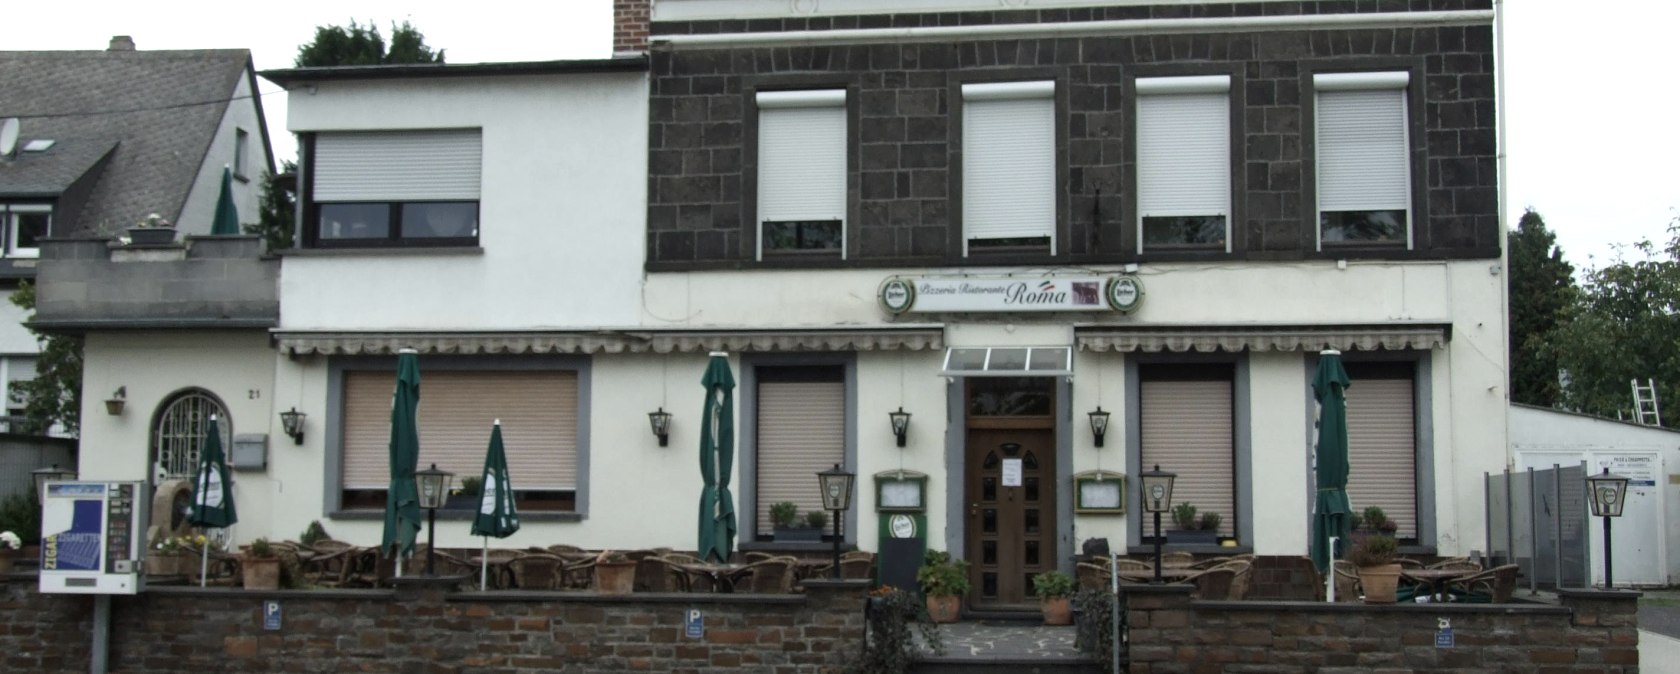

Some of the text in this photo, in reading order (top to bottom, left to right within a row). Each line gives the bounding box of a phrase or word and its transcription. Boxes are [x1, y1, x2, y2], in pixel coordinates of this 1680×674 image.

[920, 281, 1066, 305] Pizzeria Ristorante Roma
[248, 389, 260, 400] 21
[268, 603, 279, 615] P
[689, 610, 701, 622] P
